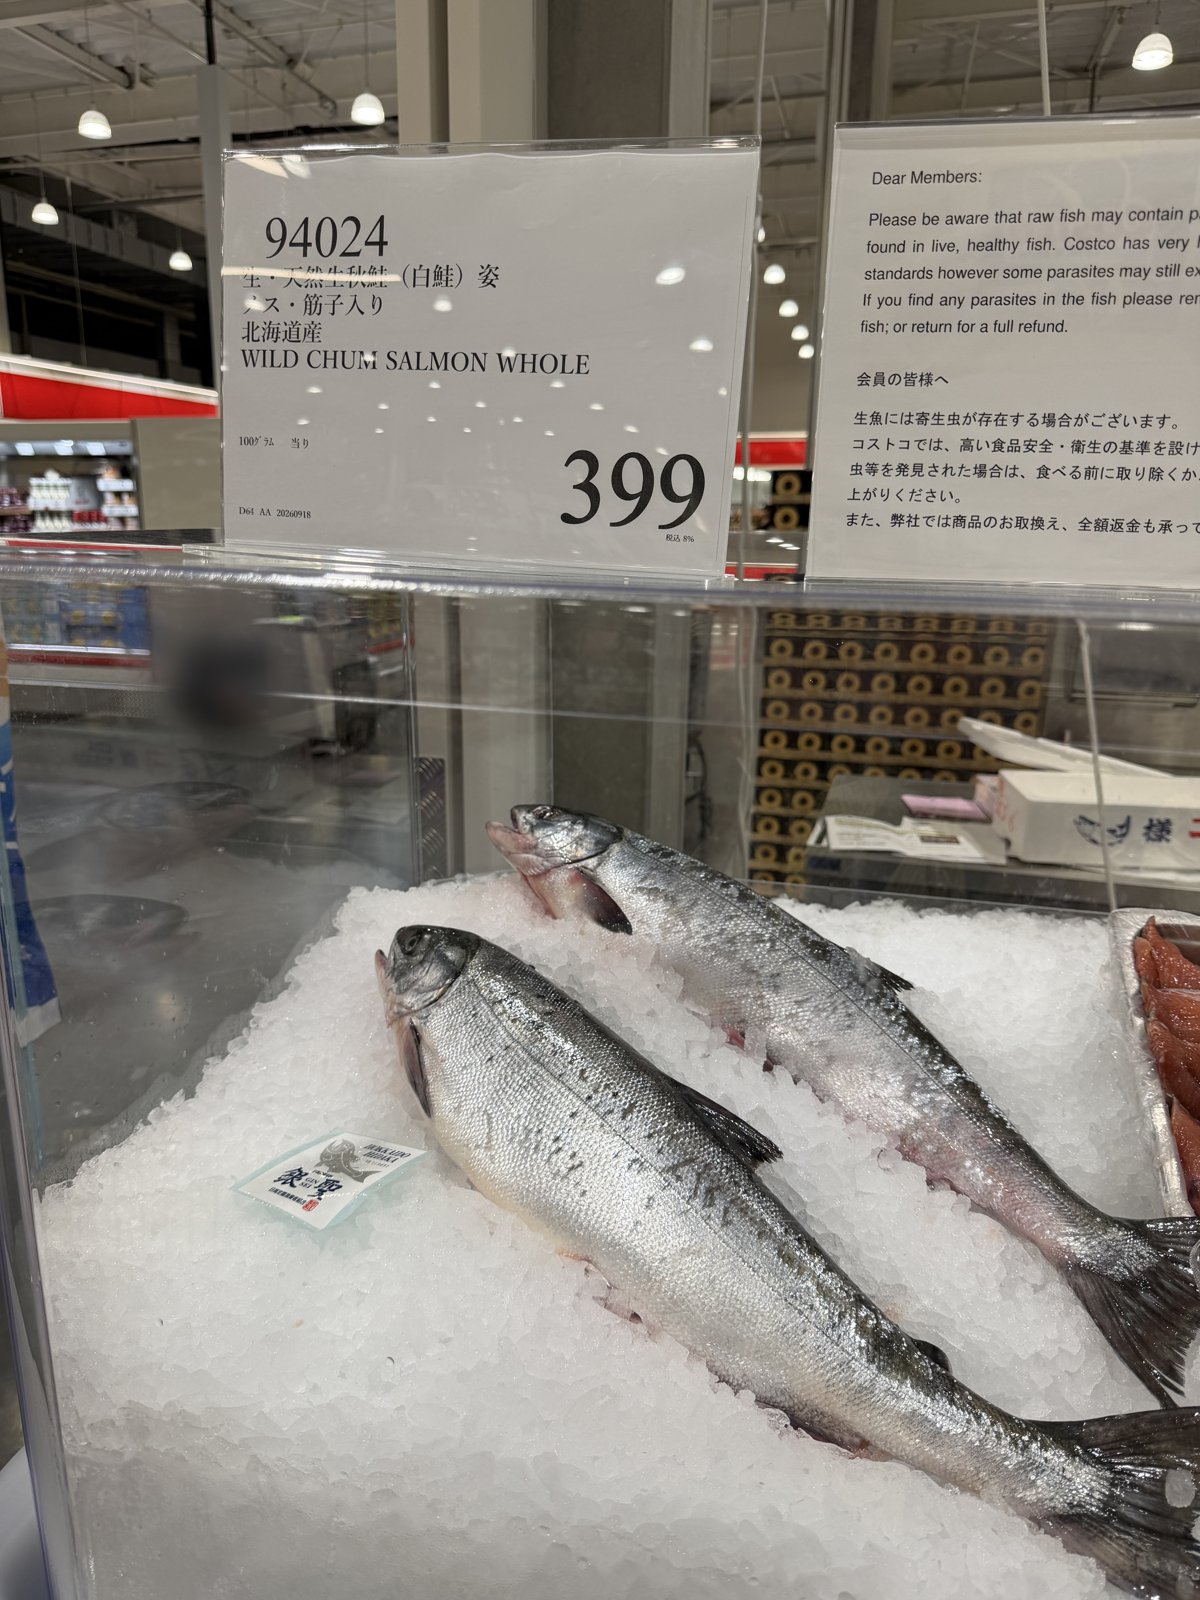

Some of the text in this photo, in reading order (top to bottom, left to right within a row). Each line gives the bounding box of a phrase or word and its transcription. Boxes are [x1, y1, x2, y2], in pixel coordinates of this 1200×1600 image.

[871, 169, 983, 186] Dear Members:
[868, 206, 1200, 227] Please be aware that raw fish may contain p
[265, 214, 389, 259] 94024
[866, 239, 907, 254] found
[912, 239, 925, 253] in
[931, 239, 960, 255] live,
[967, 237, 1020, 255] healthy
[1026, 236, 1056, 252] fish.
[1063, 236, 1116, 251] Costco
[1122, 235, 1150, 250] has
[1157, 238, 1191, 253] very
[863, 266, 934, 281] standards
[937, 265, 1000, 280] however
[1002, 267, 1043, 280] some
[1046, 264, 1115, 282] parasites
[1118, 266, 1152, 282] may
[1155, 262, 1181, 278] still
[862, 292, 873, 307] If
[876, 296, 902, 310] you
[907, 292, 934, 307] find
[939, 295, 966, 310] any
[970, 292, 1037, 310] parasites
[1042, 292, 1056, 306] in
[1061, 291, 1085, 306] the
[1091, 291, 1117, 306] fish
[1122, 291, 1173, 309] please
[241, 320, 323, 344] 北海道産
[860, 319, 1068, 336] fish; or return for a full refund.
[240, 348, 590, 375] WILD CHUM SALMON WHOLE
[856, 371, 950, 388] 会員の皆様へ
[853, 410, 1178, 430] 生魚には寄生虫が存在する場合がございます。
[291, 437, 309, 450] 当り
[852, 436, 1200, 457] コストコでは、高い食品安全・衛生の基準を設け
[559, 449, 706, 530] 399
[846, 487, 961, 504] 上がりください。
[238, 506, 312, 519] D64 AA 20260918
[665, 533, 695, 543] 税込 8%
